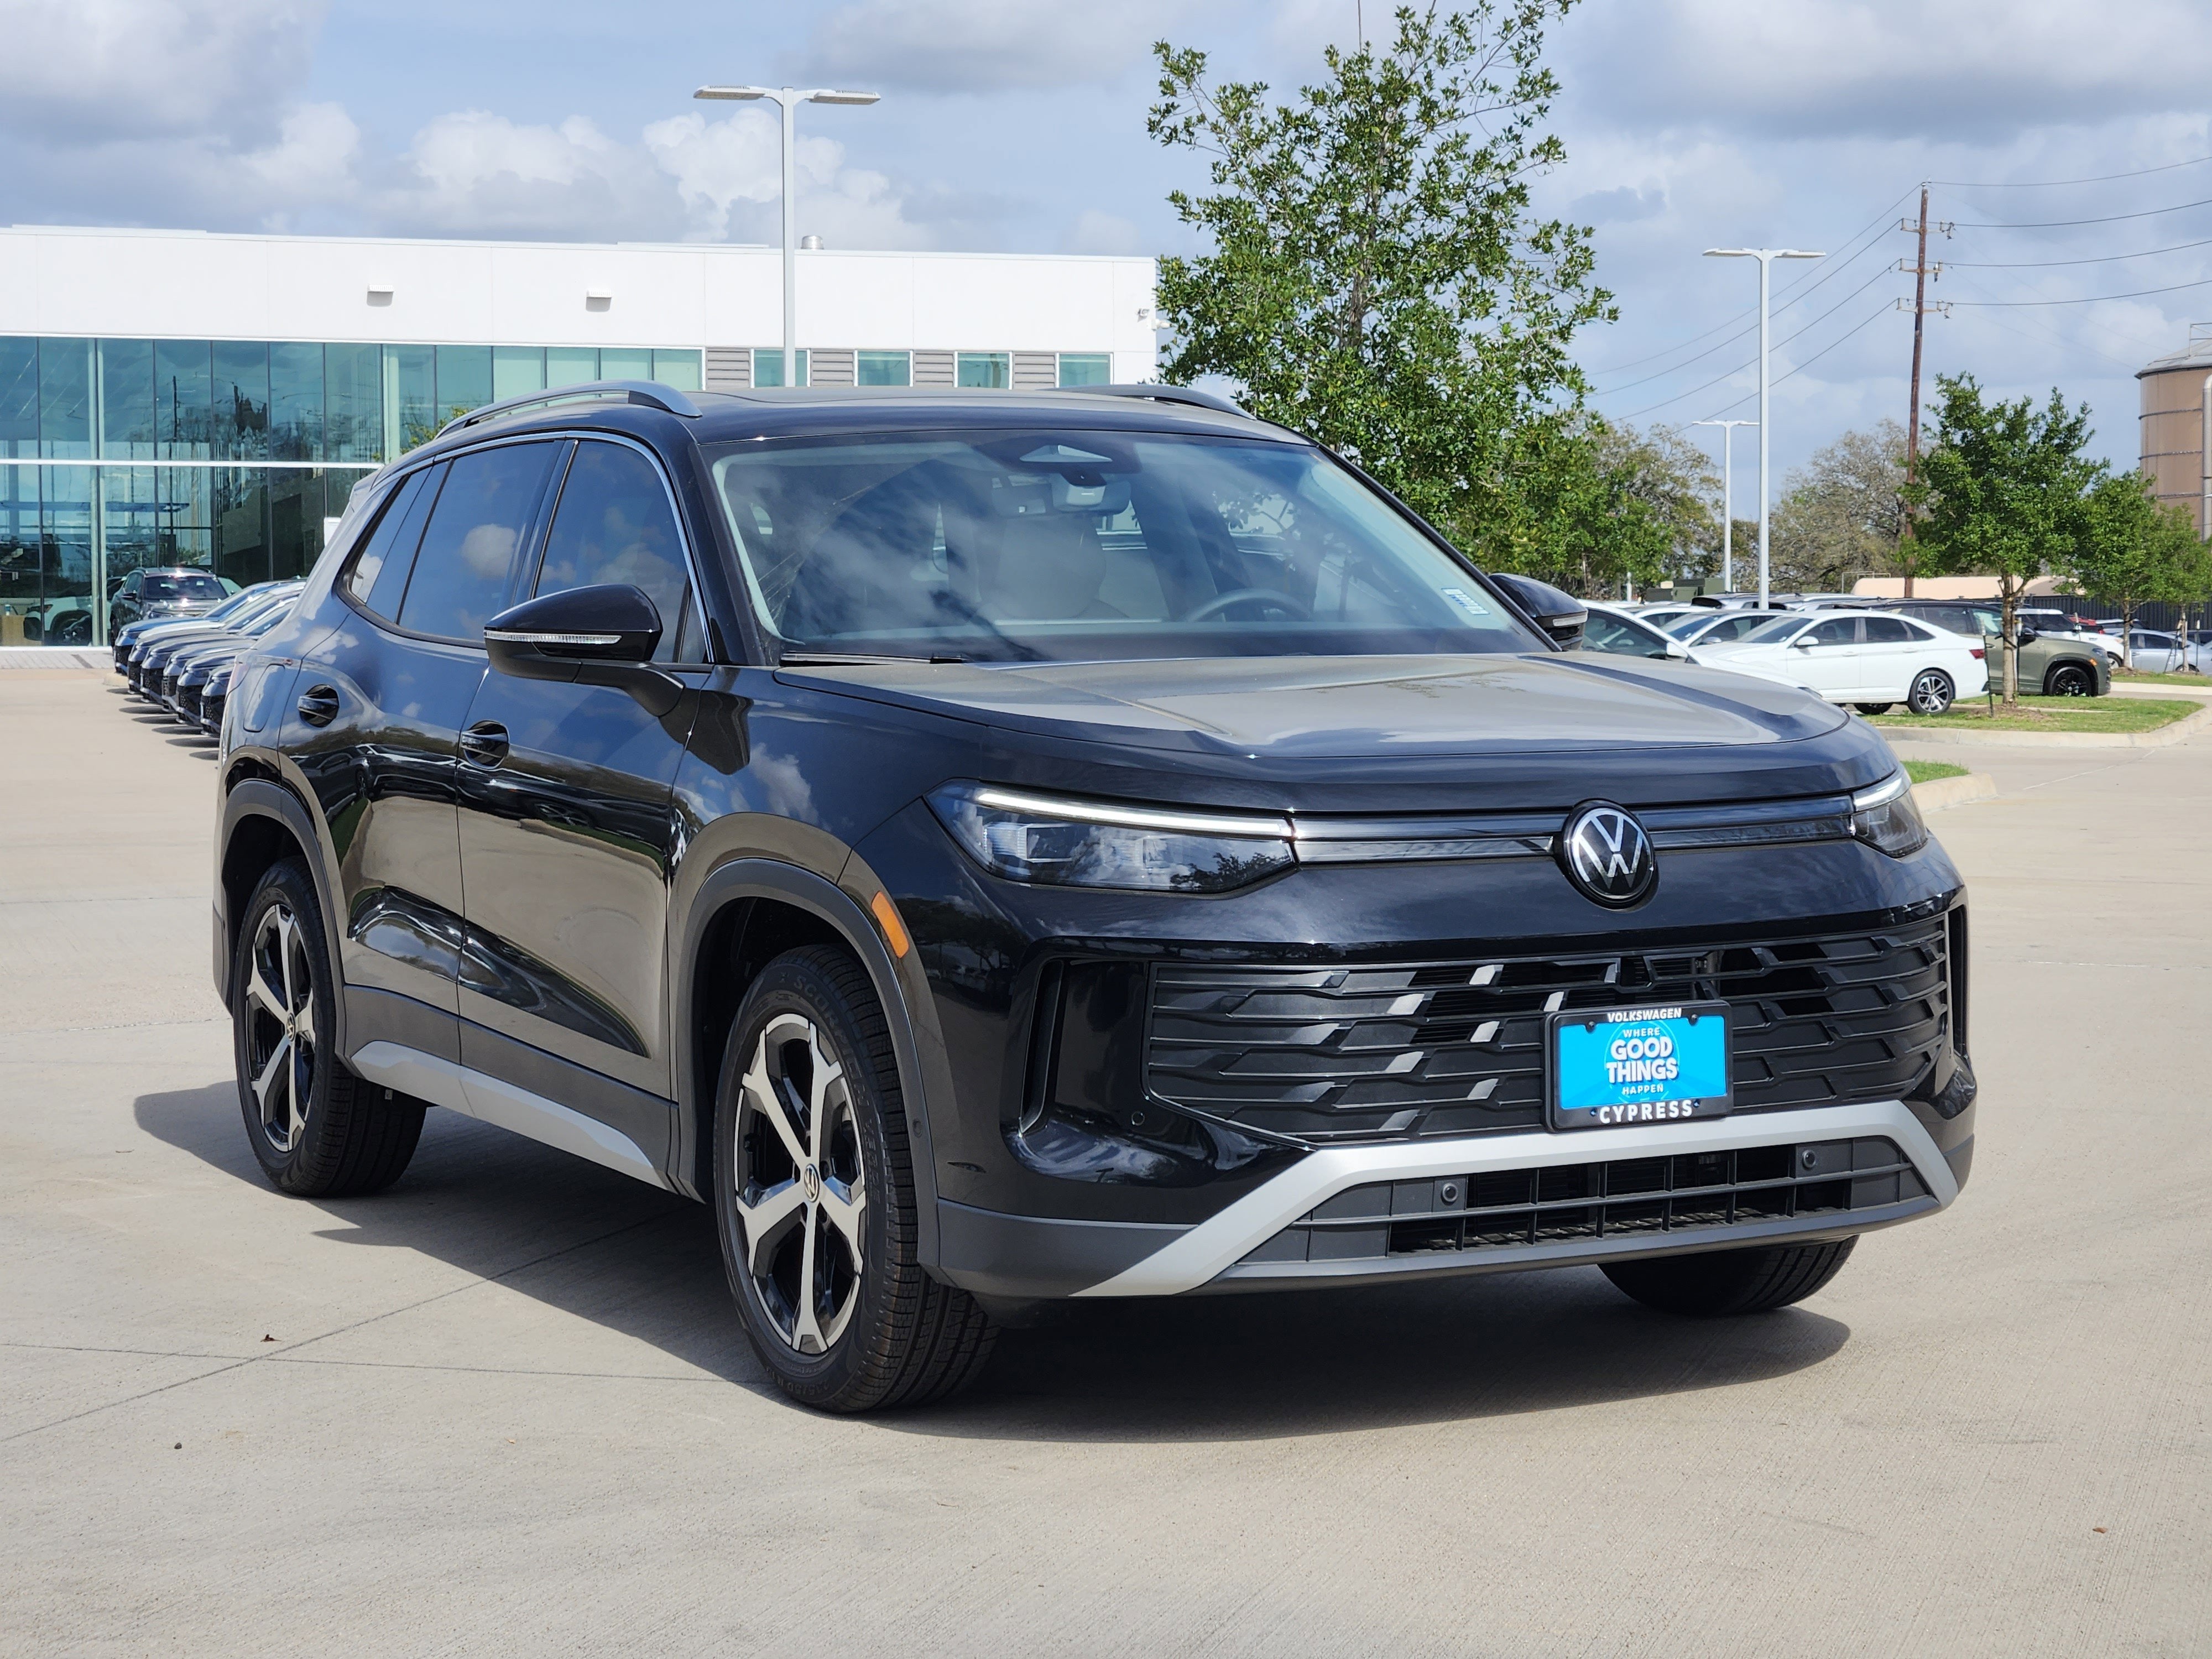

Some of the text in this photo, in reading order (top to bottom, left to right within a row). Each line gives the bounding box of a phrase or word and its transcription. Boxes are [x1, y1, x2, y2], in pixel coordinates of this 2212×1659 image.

[1574, 810, 1646, 891] VW
[1607, 1008, 1682, 1022] VOLKSWAGEN
[1623, 1027, 1660, 1037] WHERE
[1610, 1036, 1673, 1061] GOOD
[1606, 1057, 1678, 1083] THINGS
[1622, 1084, 1663, 1095] HAPPEN
[1599, 1100, 1693, 1124] CYPRESS
